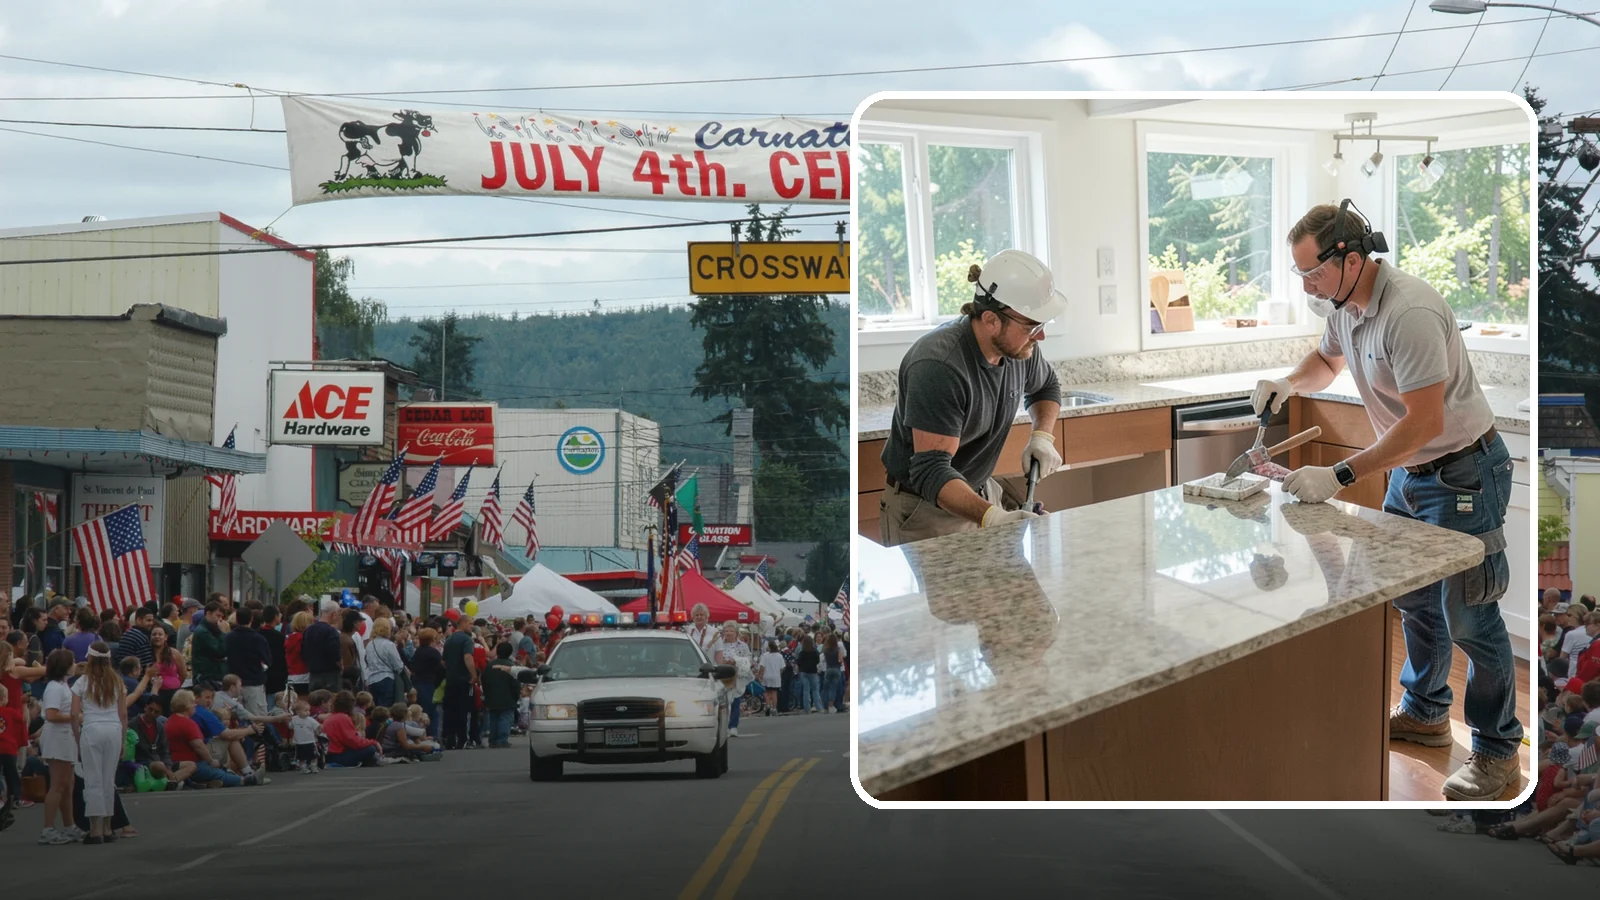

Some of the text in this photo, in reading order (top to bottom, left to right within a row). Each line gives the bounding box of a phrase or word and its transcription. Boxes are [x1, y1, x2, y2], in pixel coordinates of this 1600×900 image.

[481, 141, 604, 191] JULY
[632, 150, 746, 198] 4th.
[697, 254, 850, 280] CROSSWA
[283, 380, 373, 420] ACE
[405, 409, 485, 422] CEDAR LOG
[284, 421, 371, 436] Hardware
[416, 428, 476, 447] Coca-Cola
[353, 467, 384, 480] Simpl
[96, 485, 124, 494] Vincent
[126, 486, 135, 495] de
[137, 486, 155, 495] Paul
[81, 503, 154, 522] THT
[688, 526, 741, 535] CRNATION
[699, 535, 730, 543] GLASS
